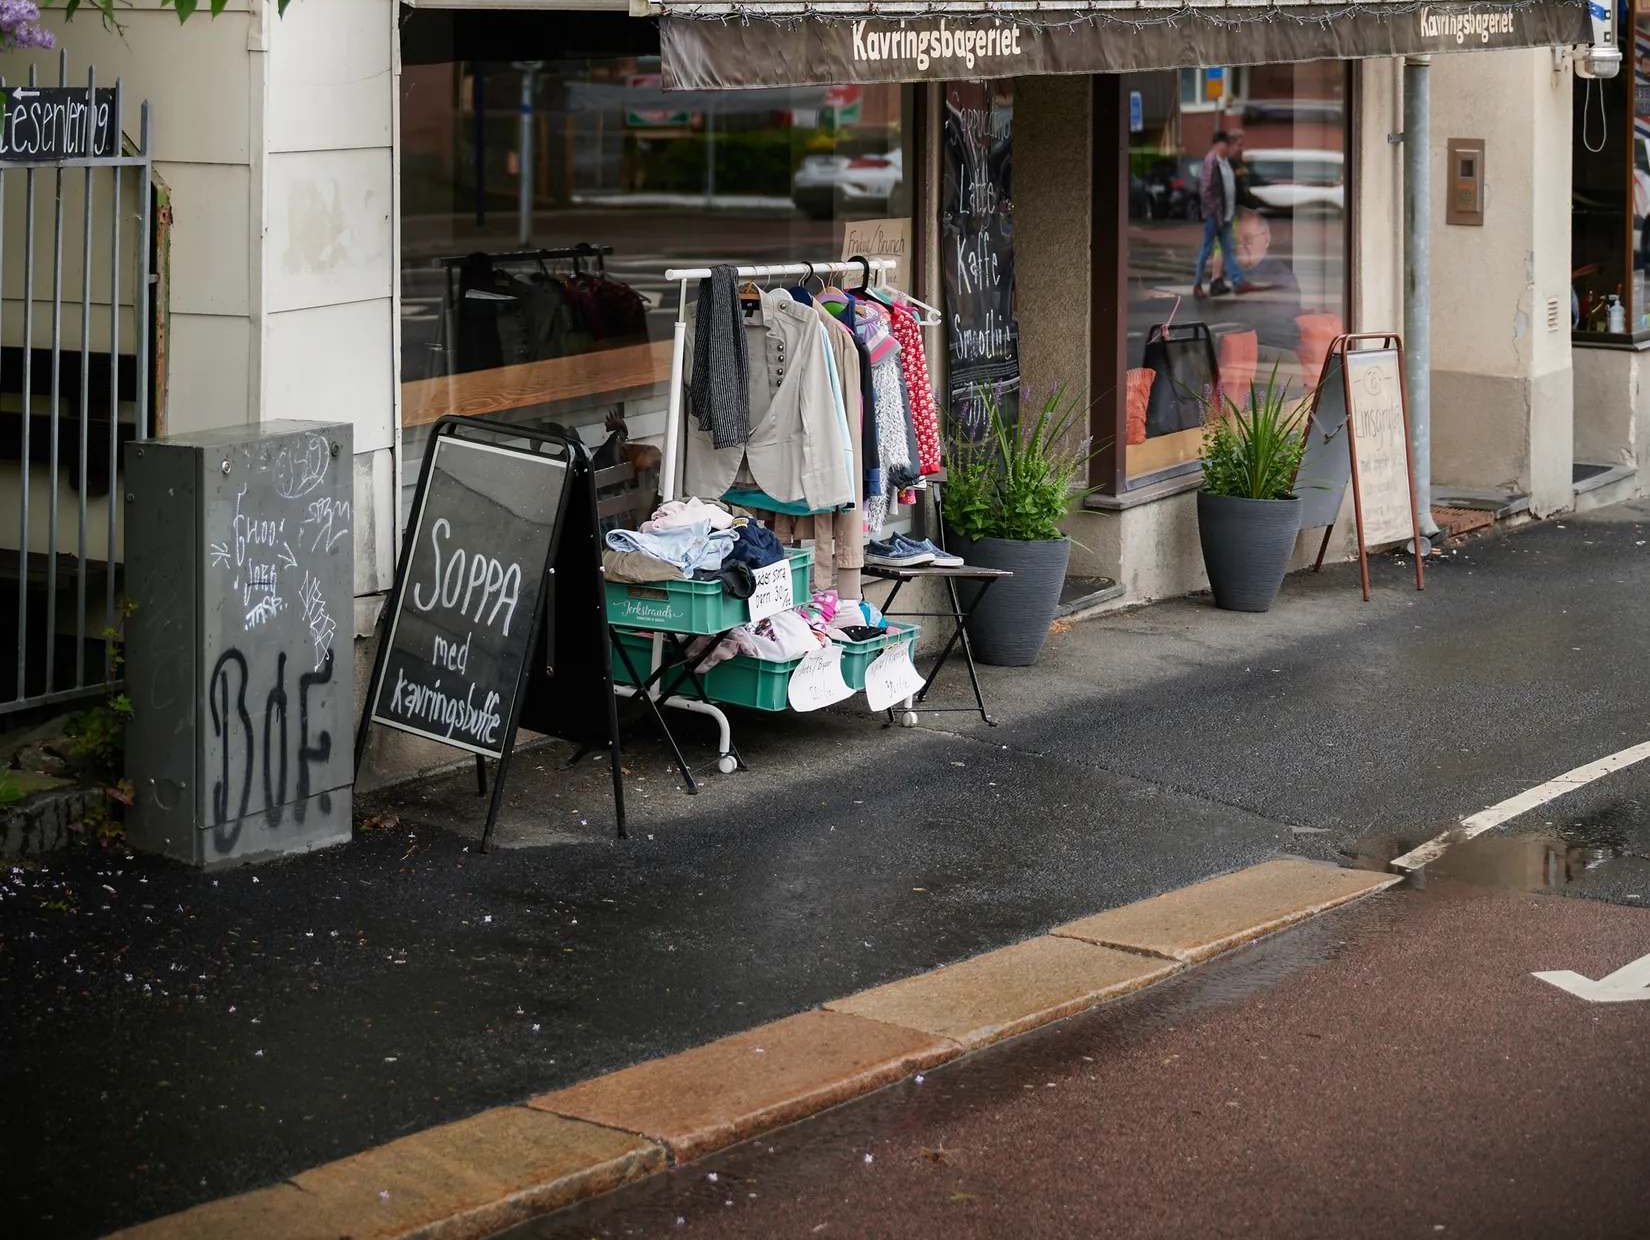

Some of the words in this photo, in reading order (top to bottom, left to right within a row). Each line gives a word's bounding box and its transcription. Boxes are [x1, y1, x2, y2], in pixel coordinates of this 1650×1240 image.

[852, 18, 1021, 71] Kavringsbageriet
[1420, 6, 1514, 44] Kavringsbageriet
[957, 231, 1001, 296] Kaffe
[432, 631, 472, 676] med
